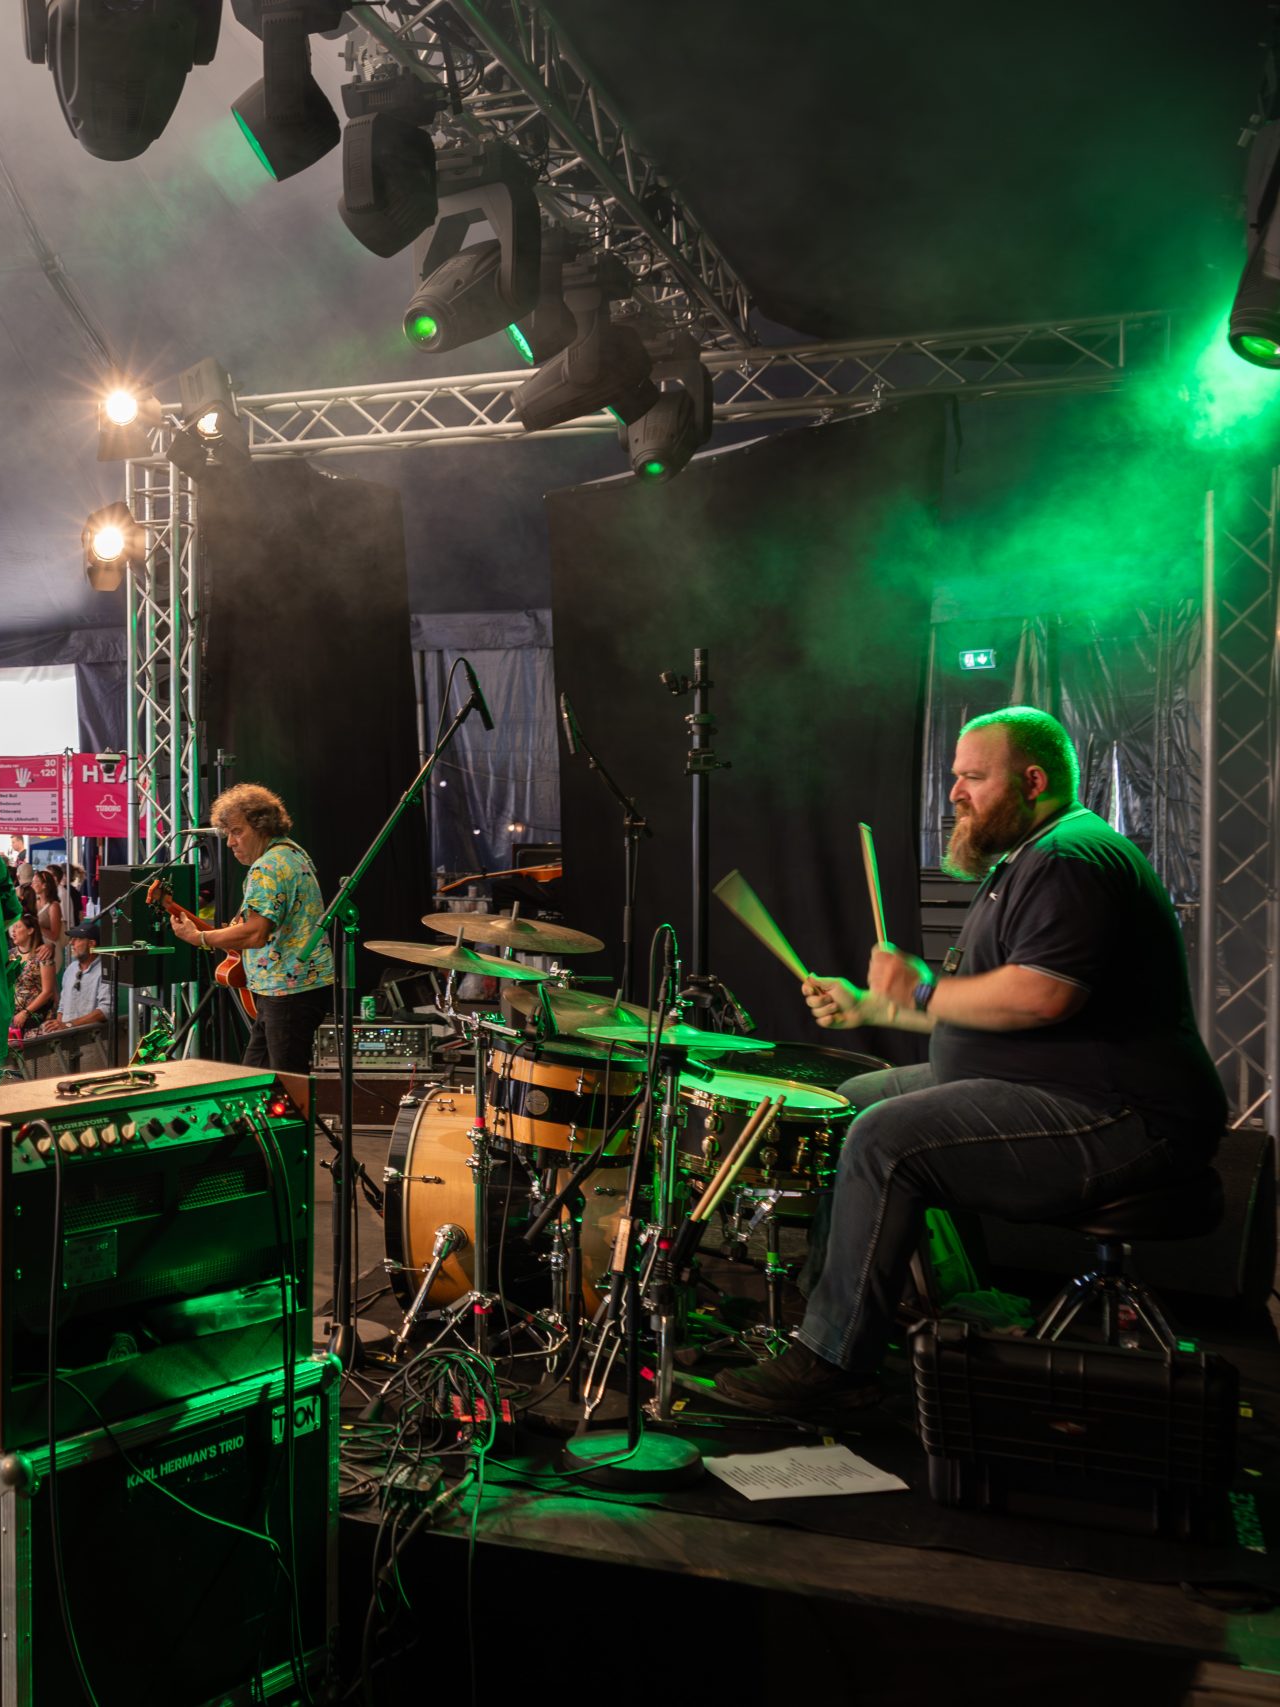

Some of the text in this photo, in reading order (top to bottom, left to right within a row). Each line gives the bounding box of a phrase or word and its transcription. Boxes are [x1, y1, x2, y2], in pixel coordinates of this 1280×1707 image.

[127, 1468, 158, 1488] KARL
[160, 1444, 217, 1477] HERMAN'S
[218, 1434, 244, 1454] TRIO
